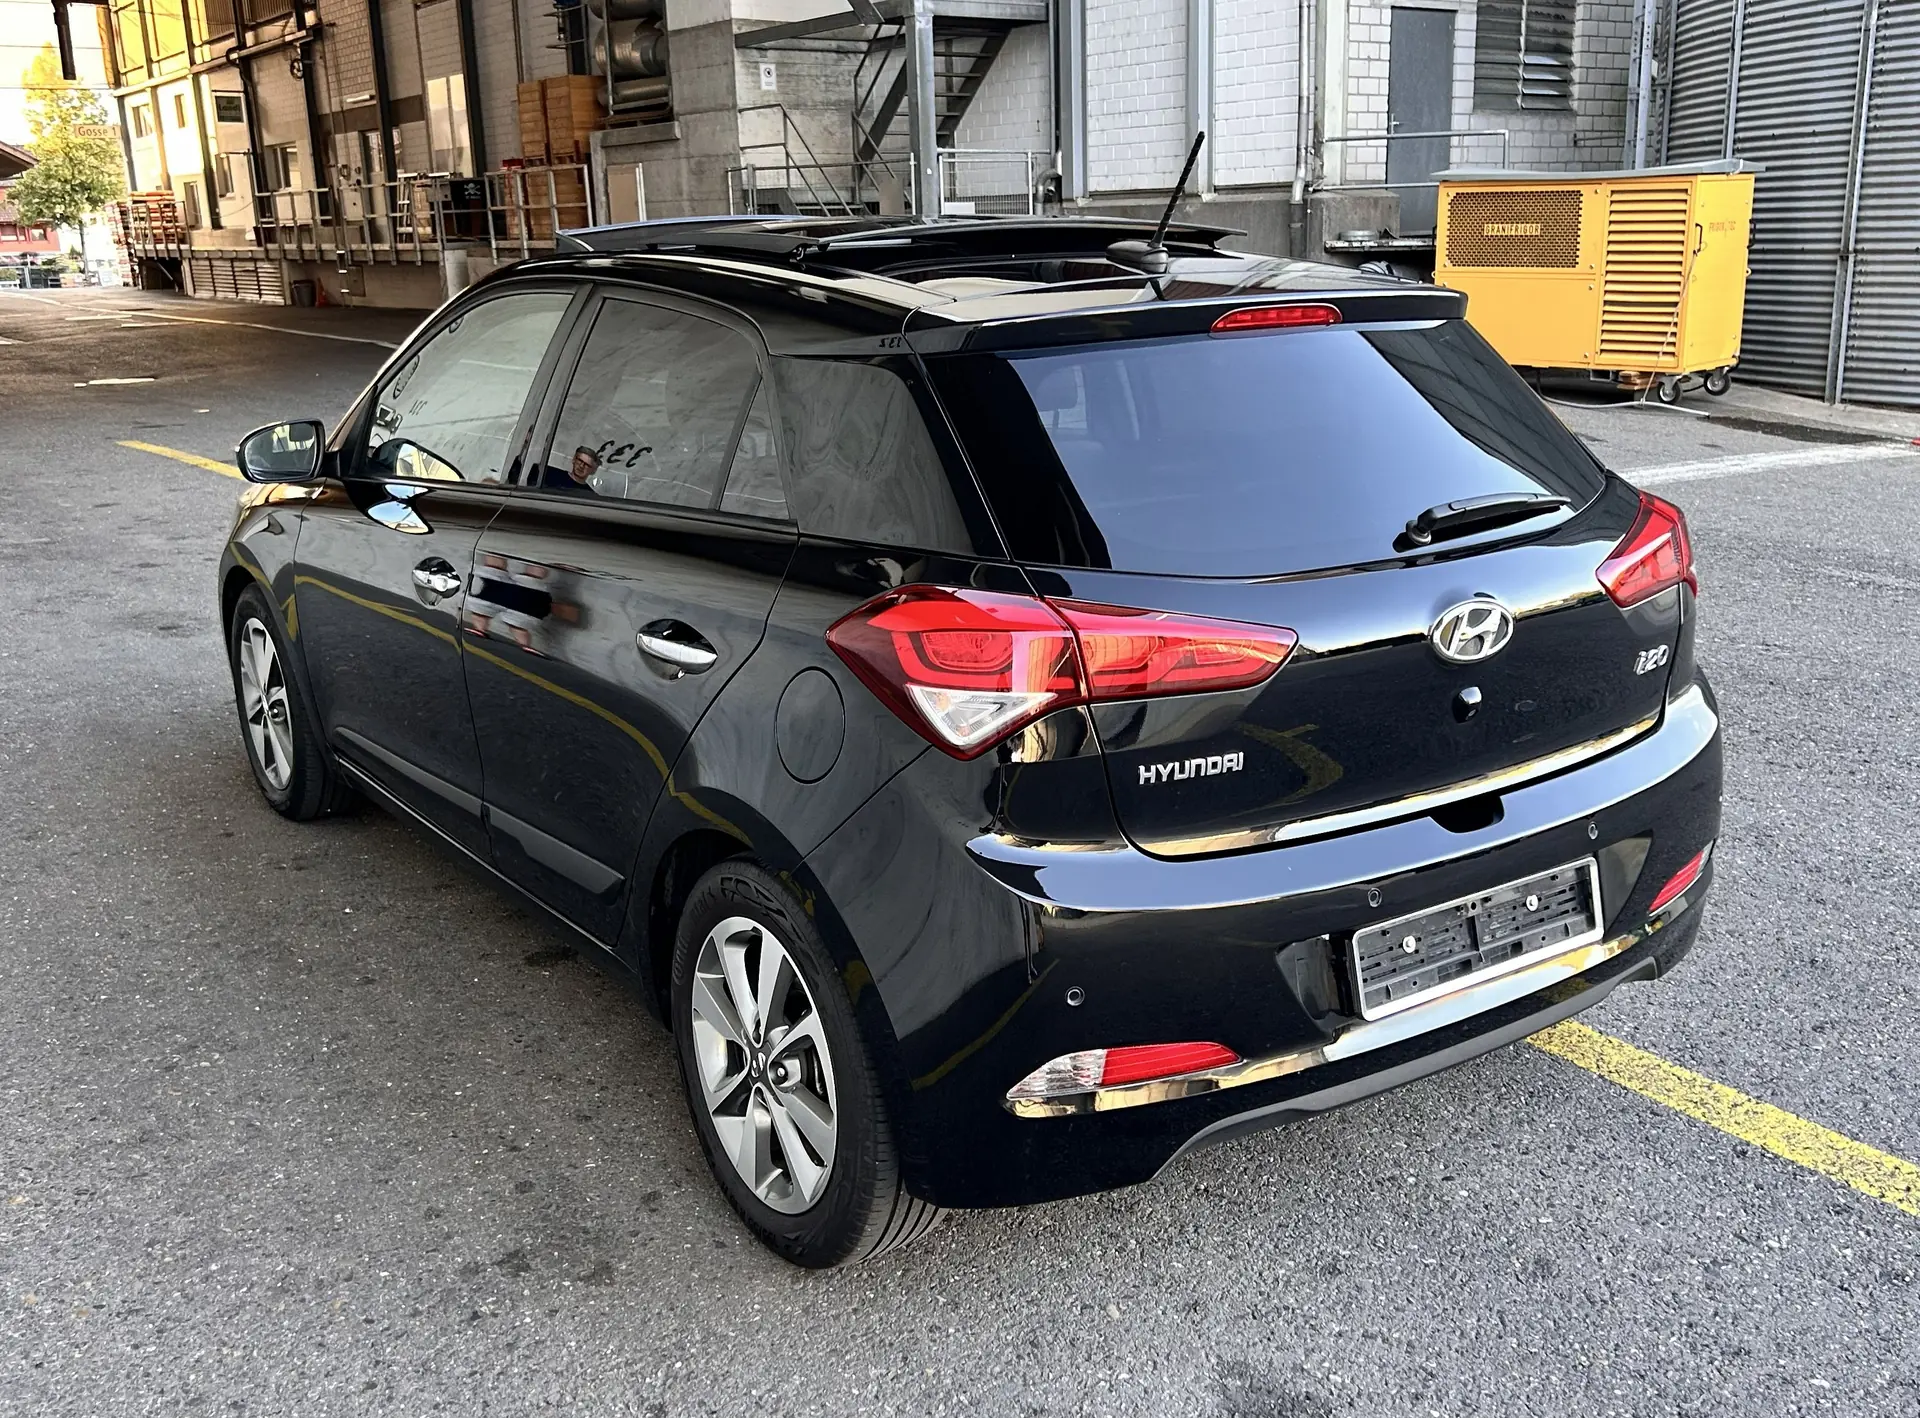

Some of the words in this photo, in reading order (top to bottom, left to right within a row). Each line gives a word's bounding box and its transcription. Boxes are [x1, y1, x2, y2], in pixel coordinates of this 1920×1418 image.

[112, 126, 117, 136] 1
[1485, 224, 1540, 234] GRANIFRIGOR
[1633, 644, 1669, 675] i20
[1138, 751, 1244, 785] HYUNDAI
